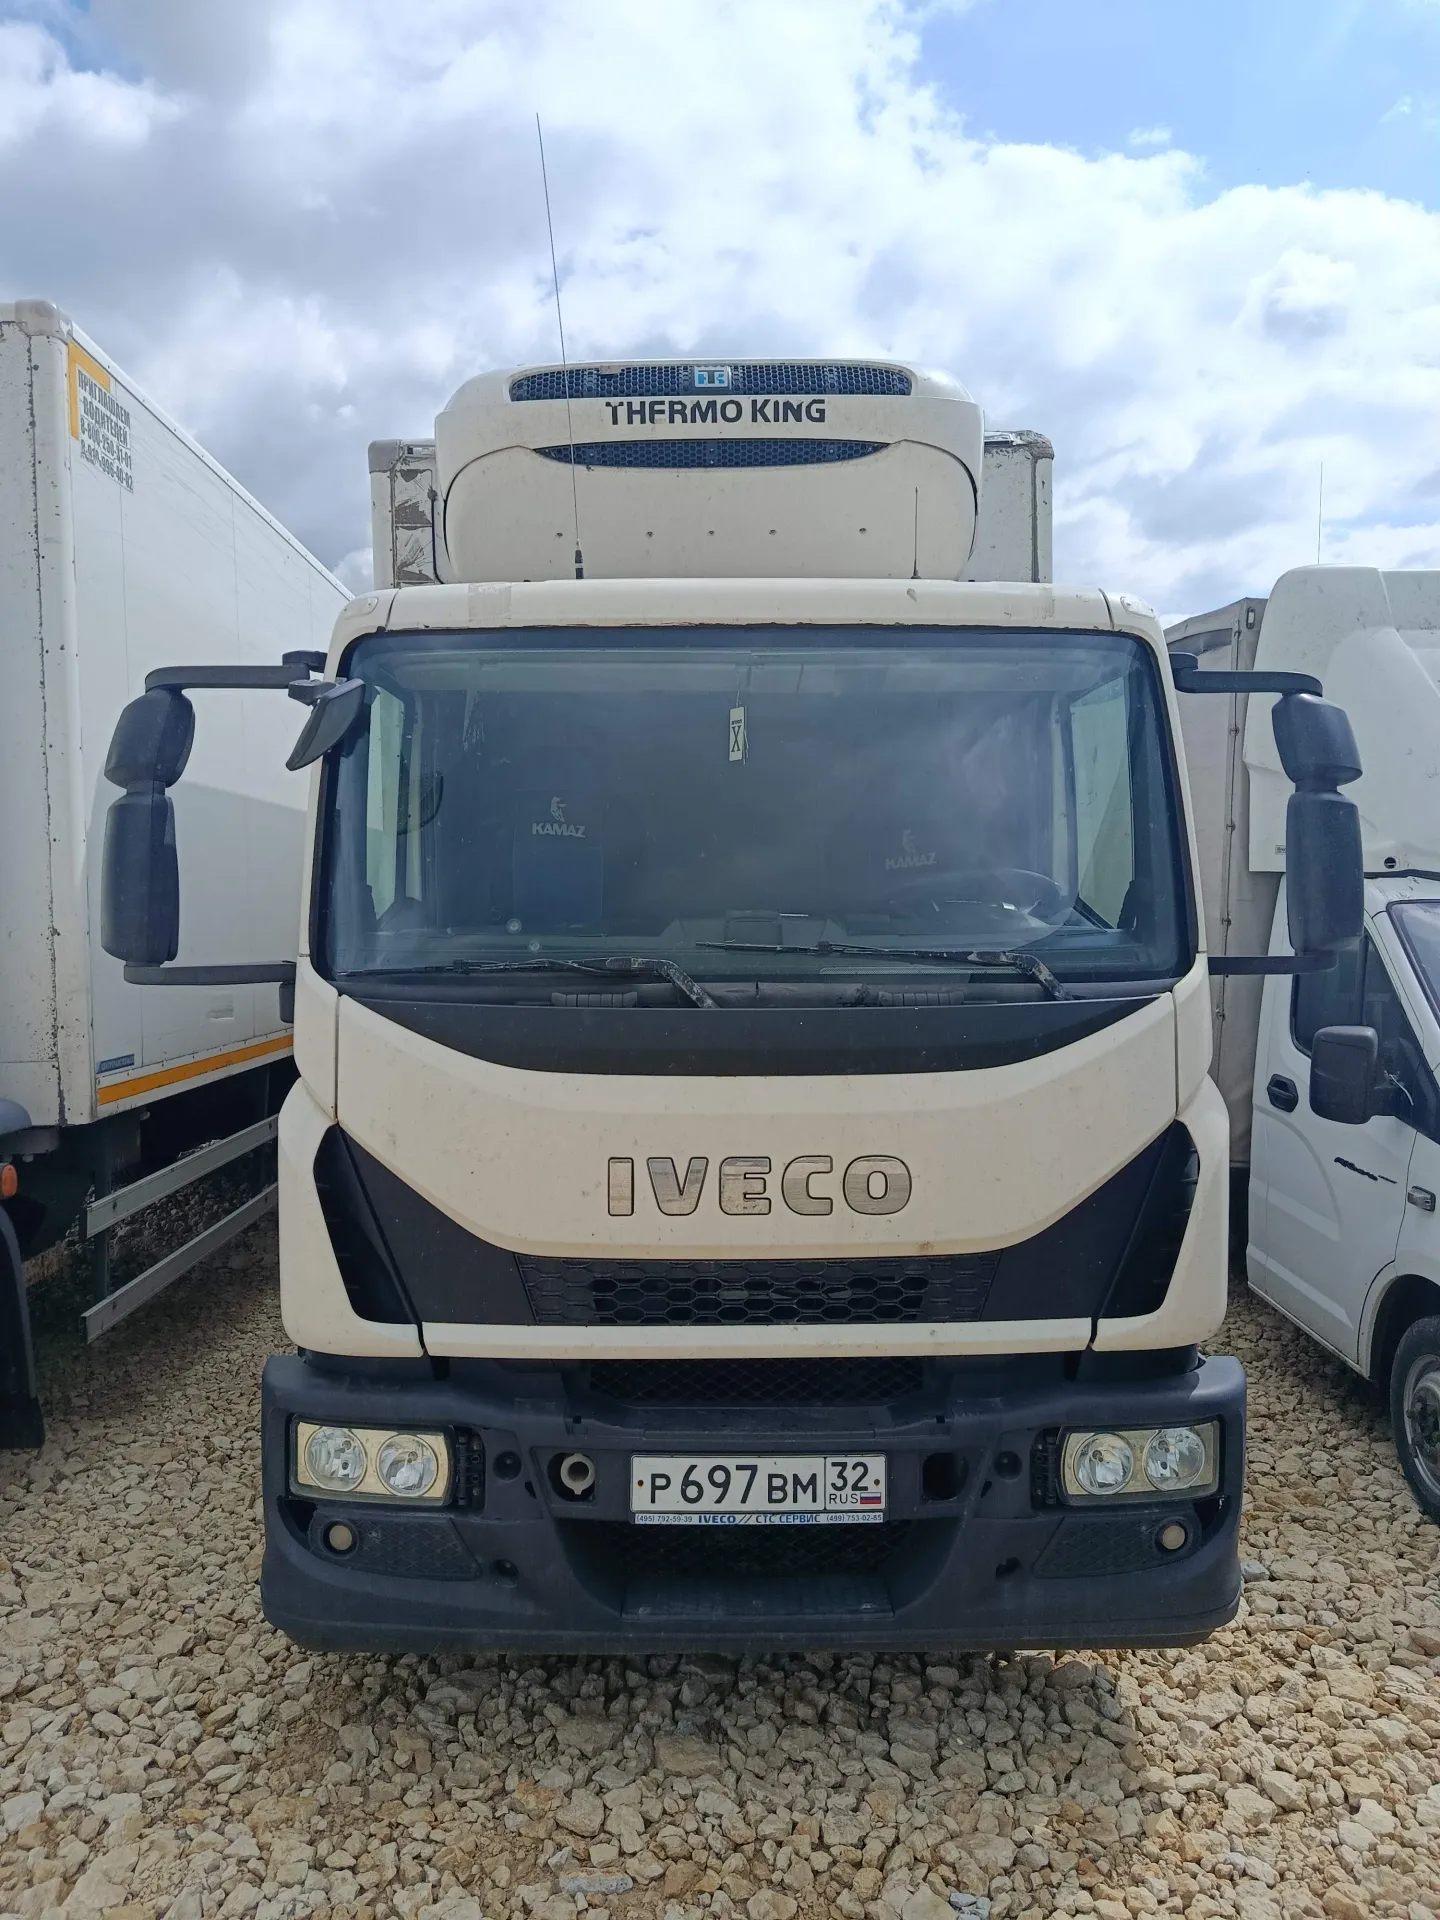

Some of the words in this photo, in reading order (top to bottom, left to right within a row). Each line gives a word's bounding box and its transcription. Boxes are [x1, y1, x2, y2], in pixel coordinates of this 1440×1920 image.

[78, 369, 131, 428] ПРИГЛАШАЕМ
[83, 396, 128, 447] ВОДИТЕЛЕЙ
[751, 399, 826, 422] KING
[532, 822, 586, 838] KAMAZ
[885, 851, 937, 870] KAMAZ
[608, 1155, 912, 1216] IVECO
[831, 1461, 868, 1491] 32
[829, 1493, 859, 1504] RUS
[637, 1514, 655, 1523] (495)
[657, 1515, 693, 1523] 792-59-39
[698, 1514, 737, 1524] IVECO
[780, 1514, 821, 1524] СЕРВИС
